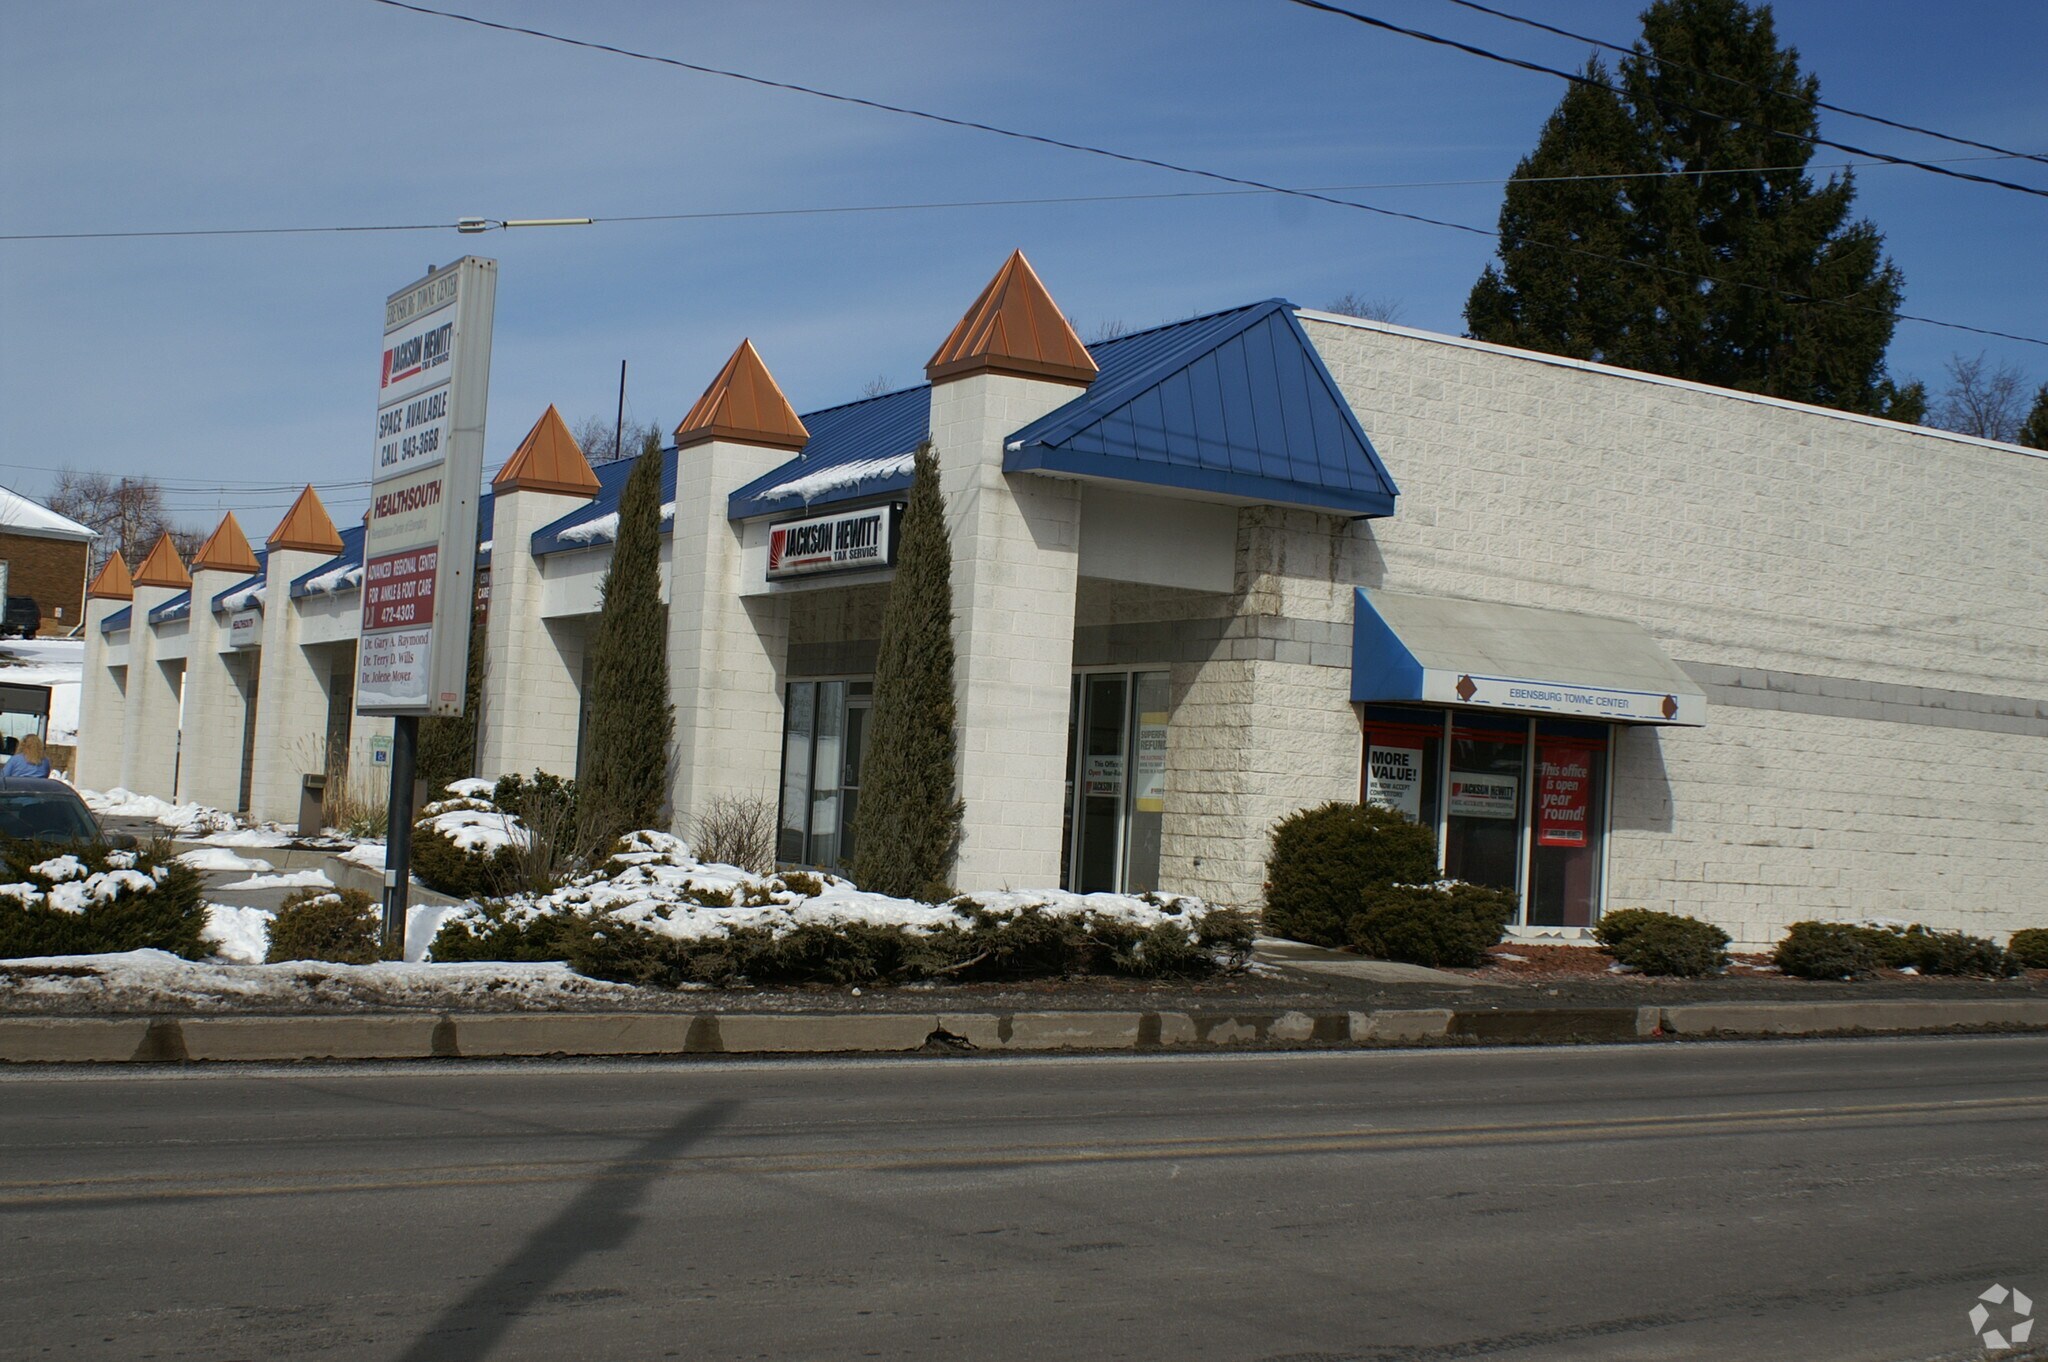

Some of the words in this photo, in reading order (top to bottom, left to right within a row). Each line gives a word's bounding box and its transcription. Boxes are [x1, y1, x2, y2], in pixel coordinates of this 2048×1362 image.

[392, 335, 423, 374] JACKSON
[424, 322, 453, 360] HEWITT
[422, 360, 430, 370] TAX
[432, 352, 450, 368] SERVICE
[379, 408, 403, 439] SPACE
[406, 391, 448, 430] AVAILABLE
[381, 442, 398, 467] CALL
[402, 428, 439, 460] 943-3668
[374, 480, 442, 519] HEALTHSOUTH
[784, 522, 834, 558] JACKSON
[835, 514, 880, 550] HEWITT
[834, 549, 847, 561] TAX
[849, 546, 878, 560] SERVICE
[368, 561, 392, 580] ADVANCED
[393, 557, 416, 576] REGIONAL
[418, 552, 437, 572] CENTER
[368, 587, 378, 604] FOR
[380, 584, 396, 602] ANKLE
[402, 581, 416, 599] FOOT
[418, 578, 432, 596] CARE
[478, 586, 490, 599] CARE
[381, 604, 415, 623] 472-4303
[364, 639, 372, 650] Dr.
[374, 636, 388, 650] Gary
[389, 636, 396, 648] A.
[398, 632, 429, 649] Raymond
[364, 656, 372, 666] Dr.
[373, 654, 388, 668] Terry
[390, 653, 396, 664] D.
[398, 651, 414, 664] Wills
[362, 672, 370, 684] Dr.
[371, 671, 392, 684] Jolene
[392, 670, 412, 684] Moyer
[1510, 688, 1562, 702] EBENSBURG
[1564, 693, 1594, 706] TOWNE
[1596, 696, 1630, 709] CENTER
[1141, 730, 1166, 739] SUPERFA
[1094, 760, 1104, 768] This
[1372, 751, 1409, 766] MORE
[1088, 769, 1101, 777] Open
[1372, 766, 1416, 782] VALUE!
[1542, 762, 1560, 776] This
[1562, 764, 1588, 778] office
[1092, 782, 1112, 791] JACKSON
[1462, 784, 1489, 794] JACKSON
[1490, 785, 1513, 796] HEWITT
[1546, 776, 1554, 790] is
[1556, 780, 1578, 793] open
[1541, 794, 1572, 808] year
[1544, 806, 1586, 820] round!
